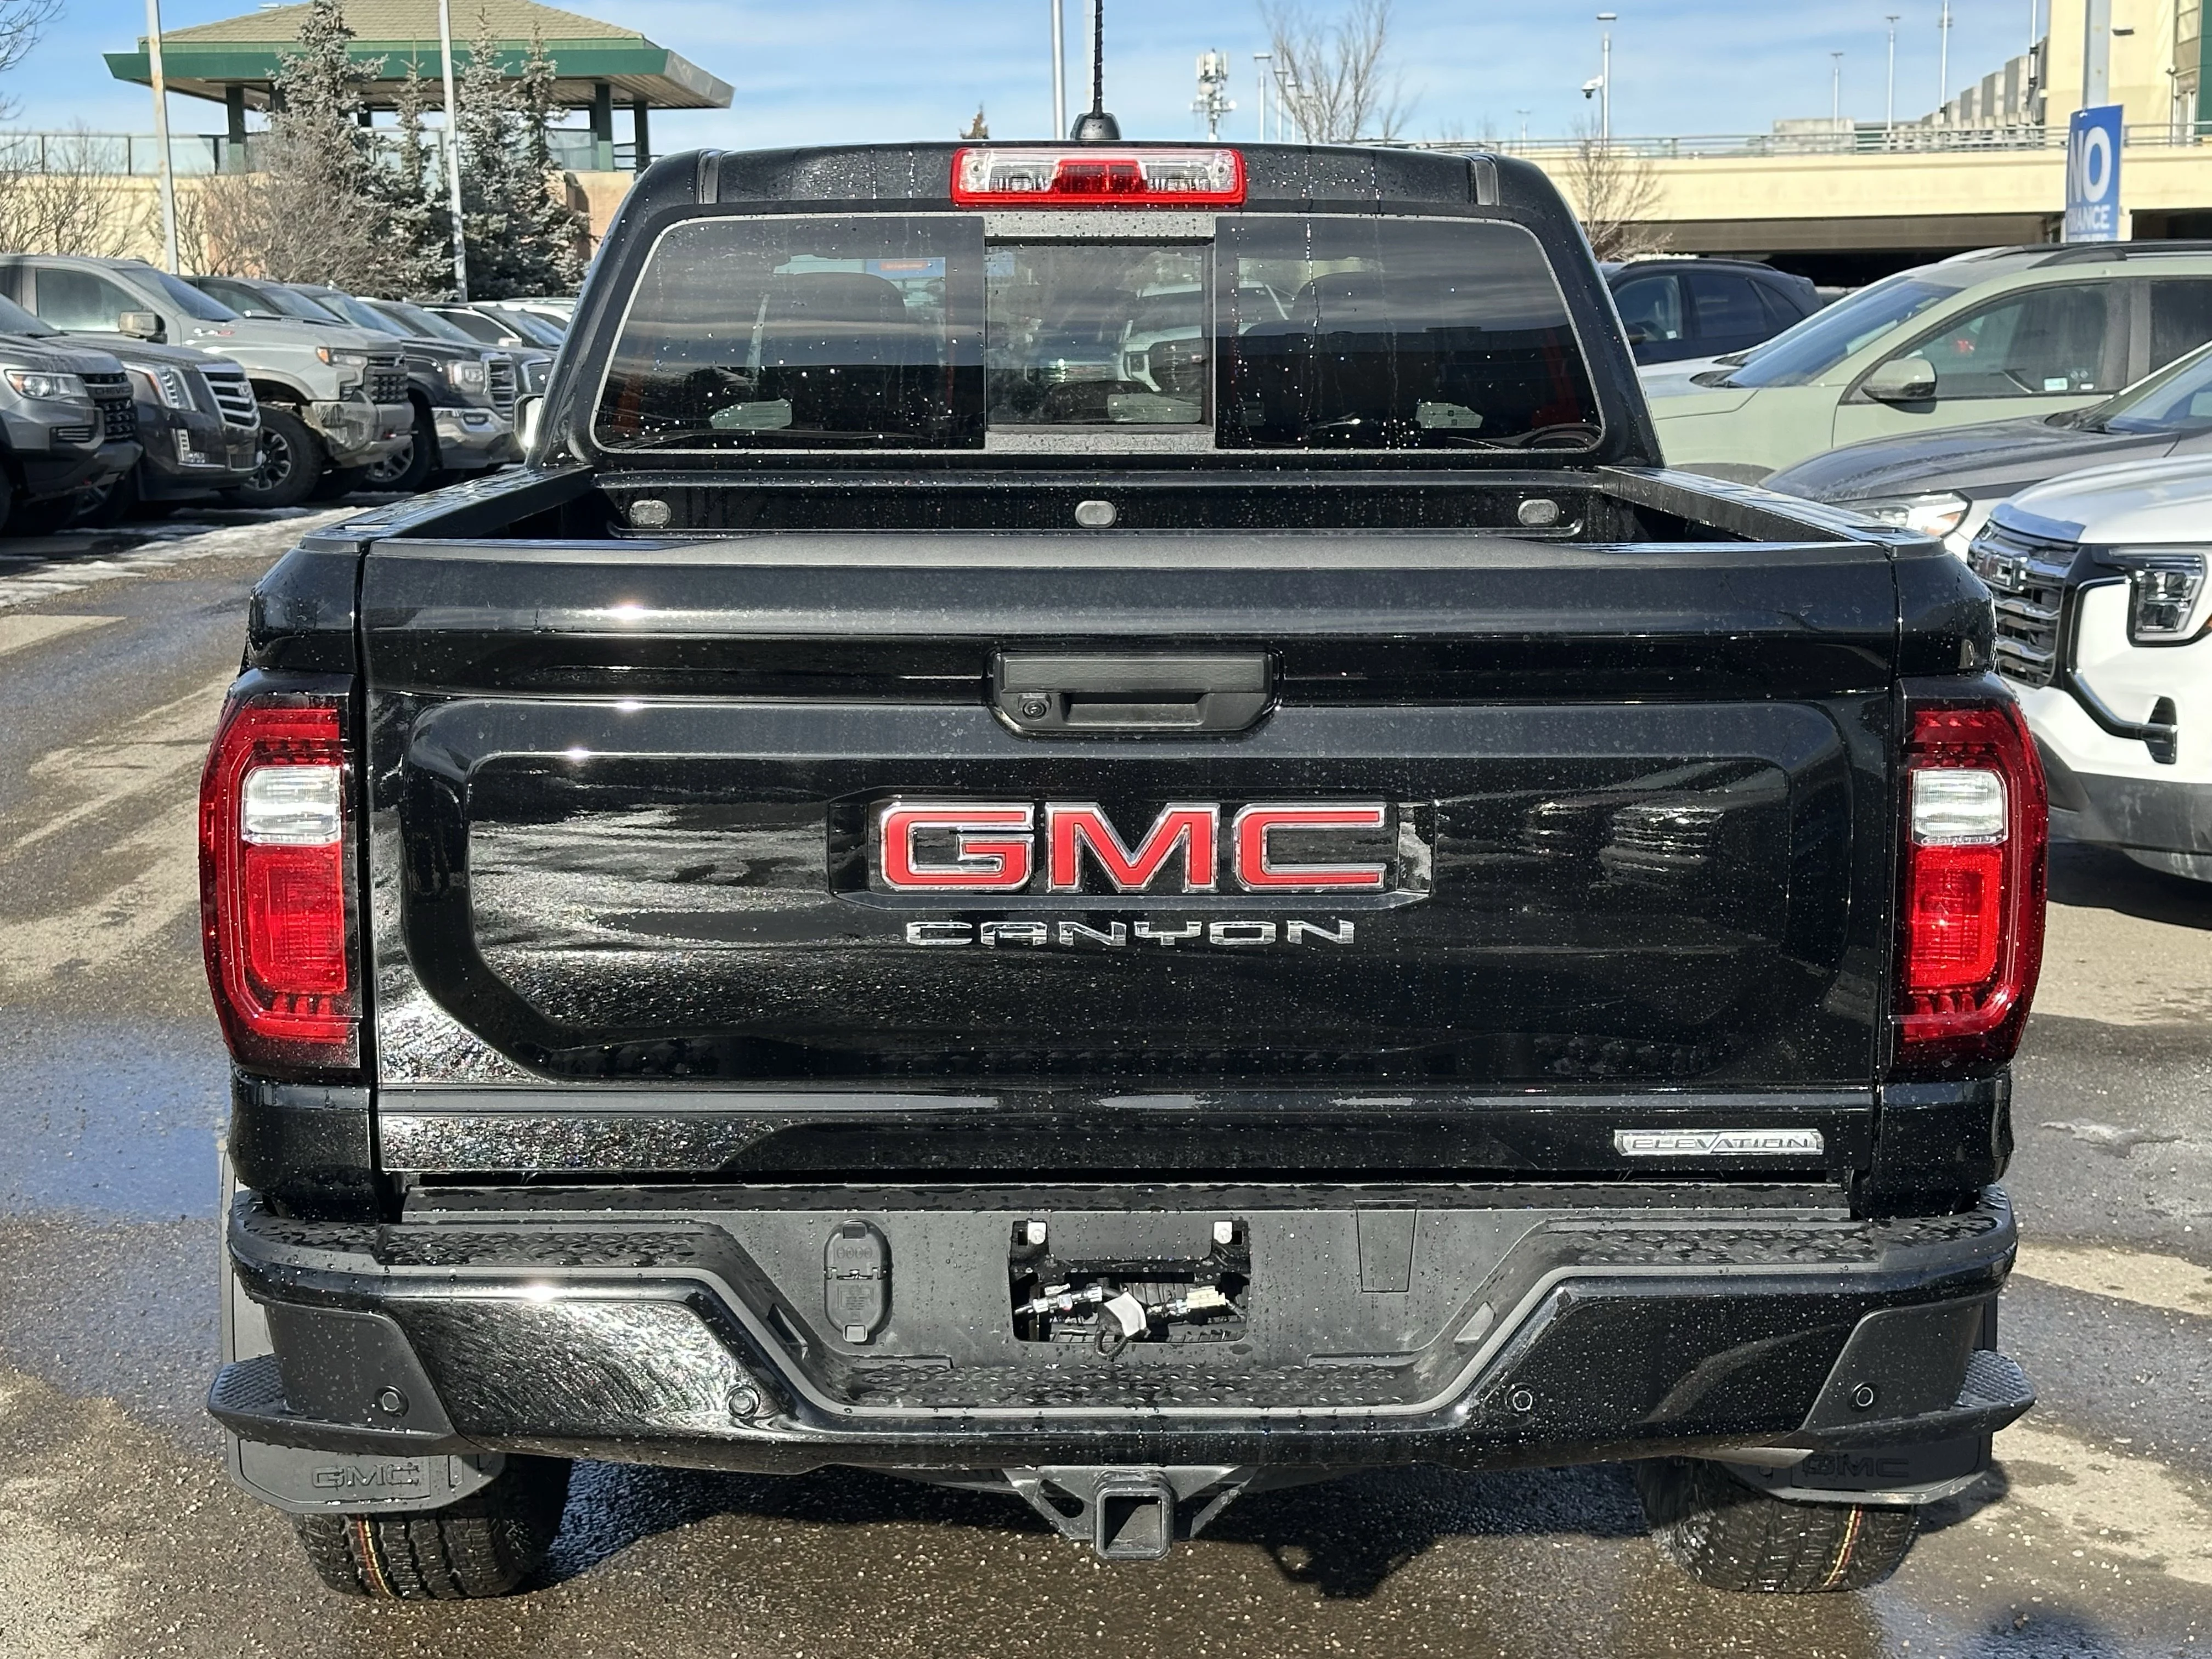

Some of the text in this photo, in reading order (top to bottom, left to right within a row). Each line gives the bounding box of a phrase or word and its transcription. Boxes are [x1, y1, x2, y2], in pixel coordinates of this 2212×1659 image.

[2068, 126, 2111, 204] NO
[880, 802, 1386, 893] GMC
[906, 920, 1355, 946] CANYON
[1630, 1136, 1810, 1152] ELEVATION
[312, 1463, 420, 1488] GMC
[1802, 1454, 1910, 1478] GMC
